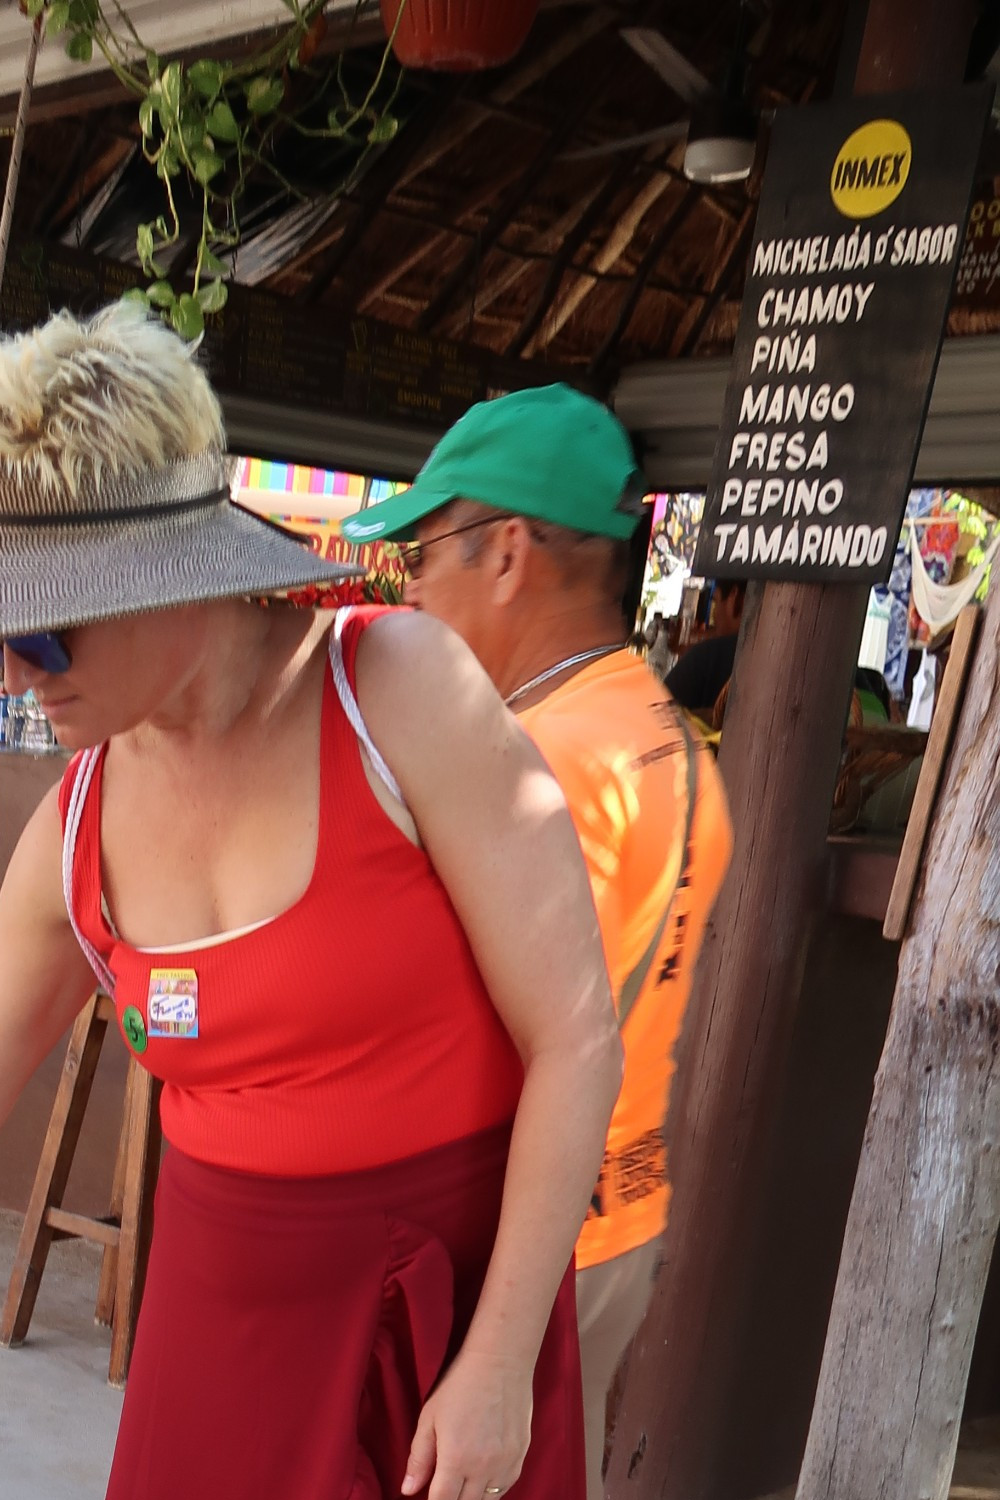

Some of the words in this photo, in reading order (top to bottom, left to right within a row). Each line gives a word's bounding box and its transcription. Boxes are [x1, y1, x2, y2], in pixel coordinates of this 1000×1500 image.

[833, 151, 907, 192] INMEX
[757, 282, 875, 328] CHAMOY
[738, 383, 855, 425] MANGO
[729, 430, 829, 471] FRESA
[719, 478, 844, 518] PEPINO
